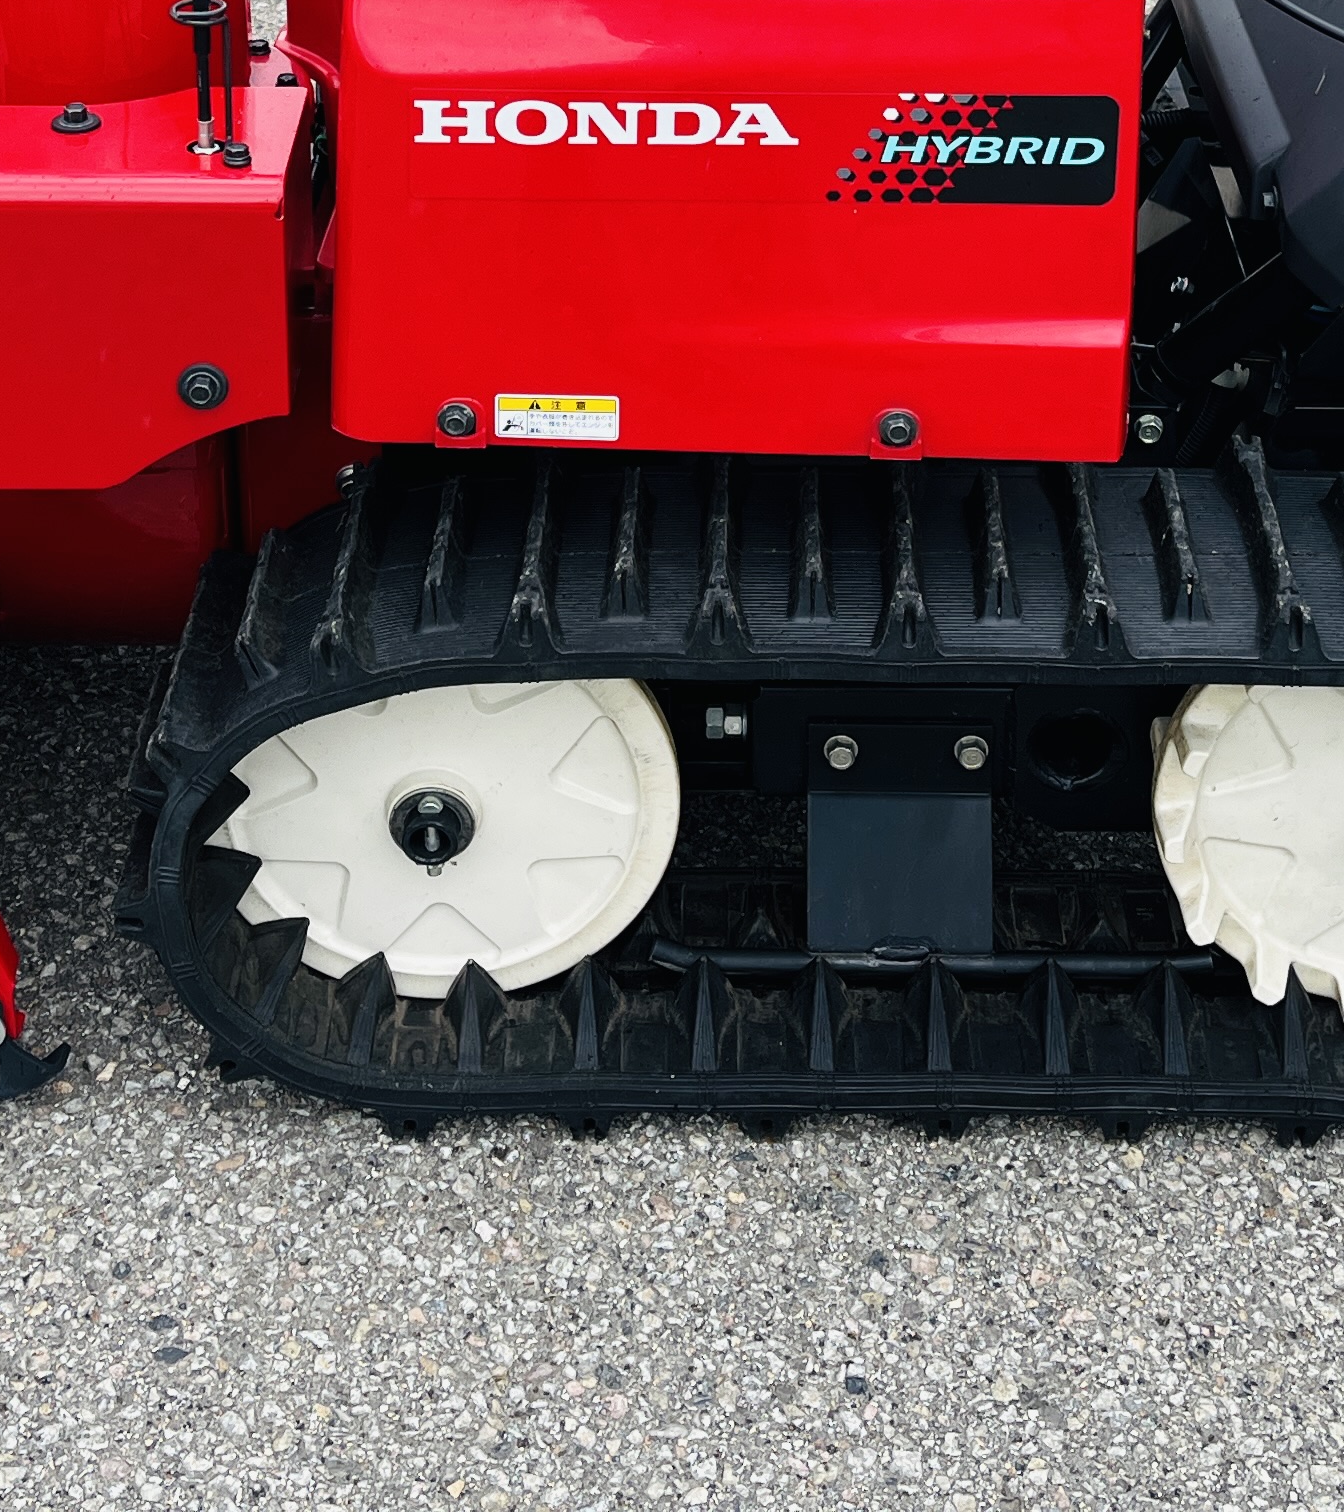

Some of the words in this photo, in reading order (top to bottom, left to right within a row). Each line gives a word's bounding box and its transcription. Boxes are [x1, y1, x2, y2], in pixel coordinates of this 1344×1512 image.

[413, 99, 800, 146] HONDA
[880, 135, 1106, 166] HYBRID
[551, 400, 587, 411] 注意
